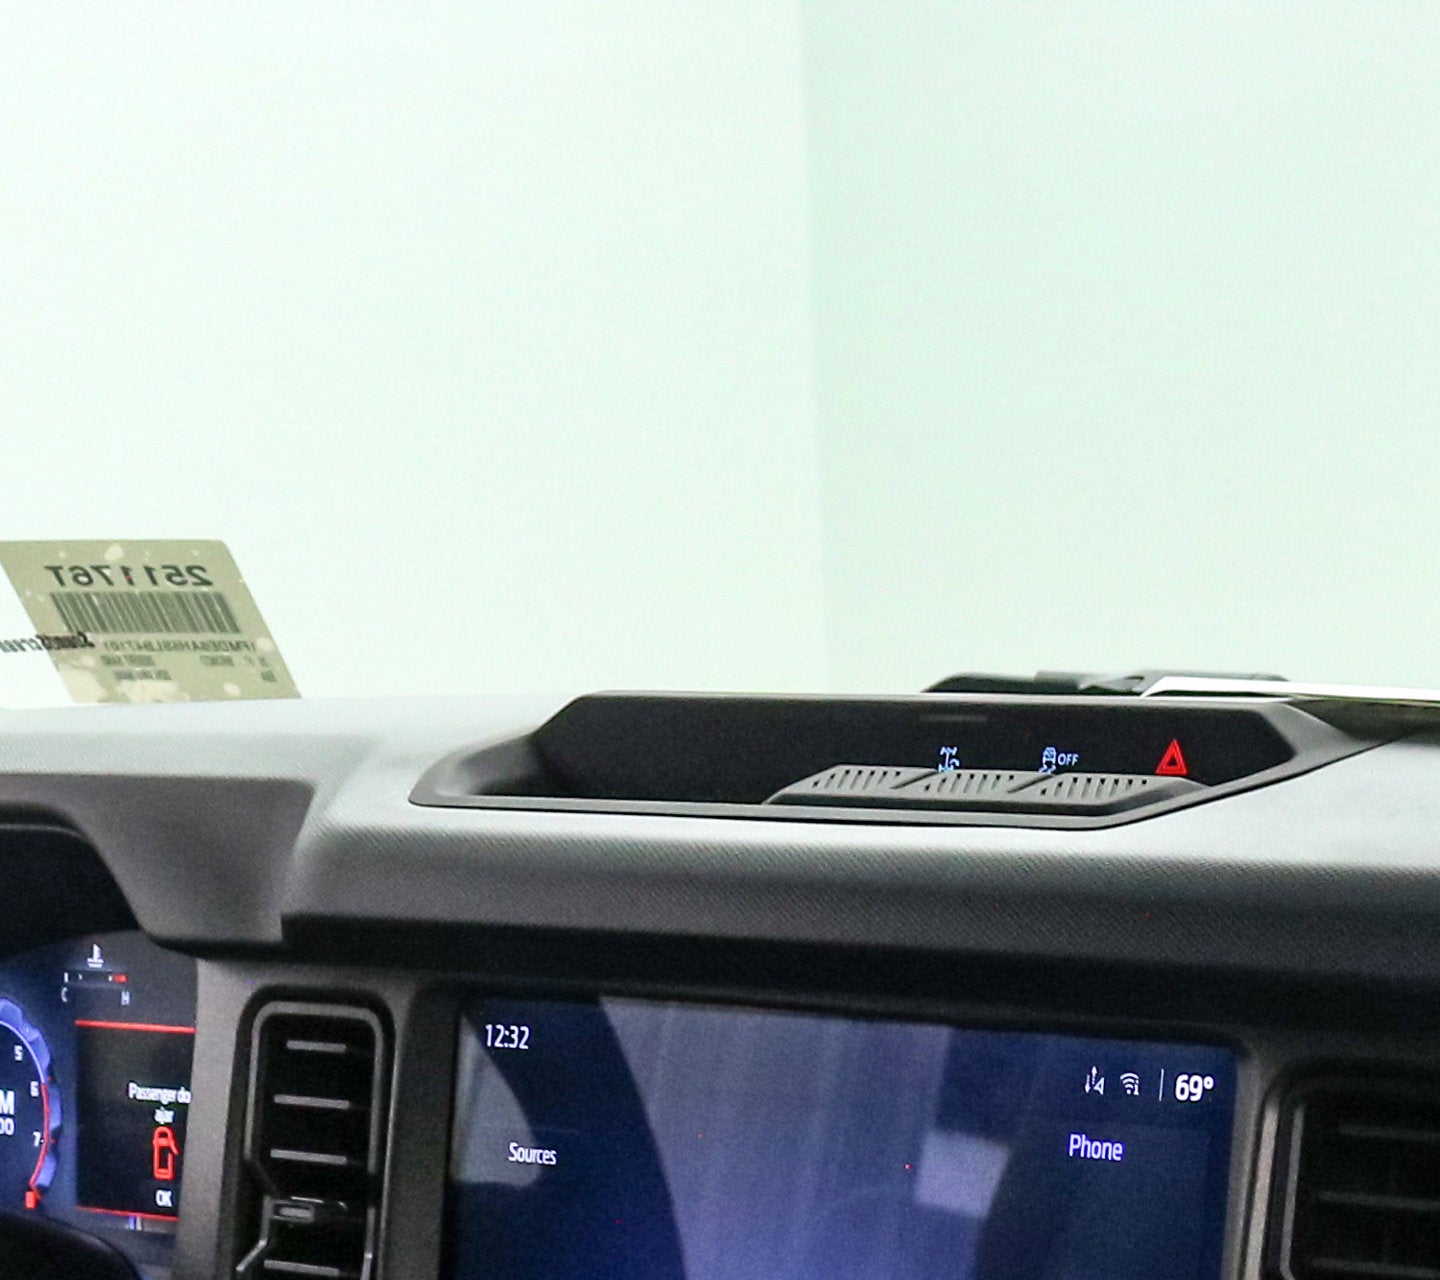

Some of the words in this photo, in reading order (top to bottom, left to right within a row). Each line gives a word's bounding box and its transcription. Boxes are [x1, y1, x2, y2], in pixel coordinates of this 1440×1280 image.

[1057, 752, 1079, 767] OFF
[484, 1022, 531, 1050] 12:32
[1174, 1073, 1215, 1104] 69°
[507, 1141, 558, 1167] Sources
[1068, 1133, 1124, 1162] Phone
